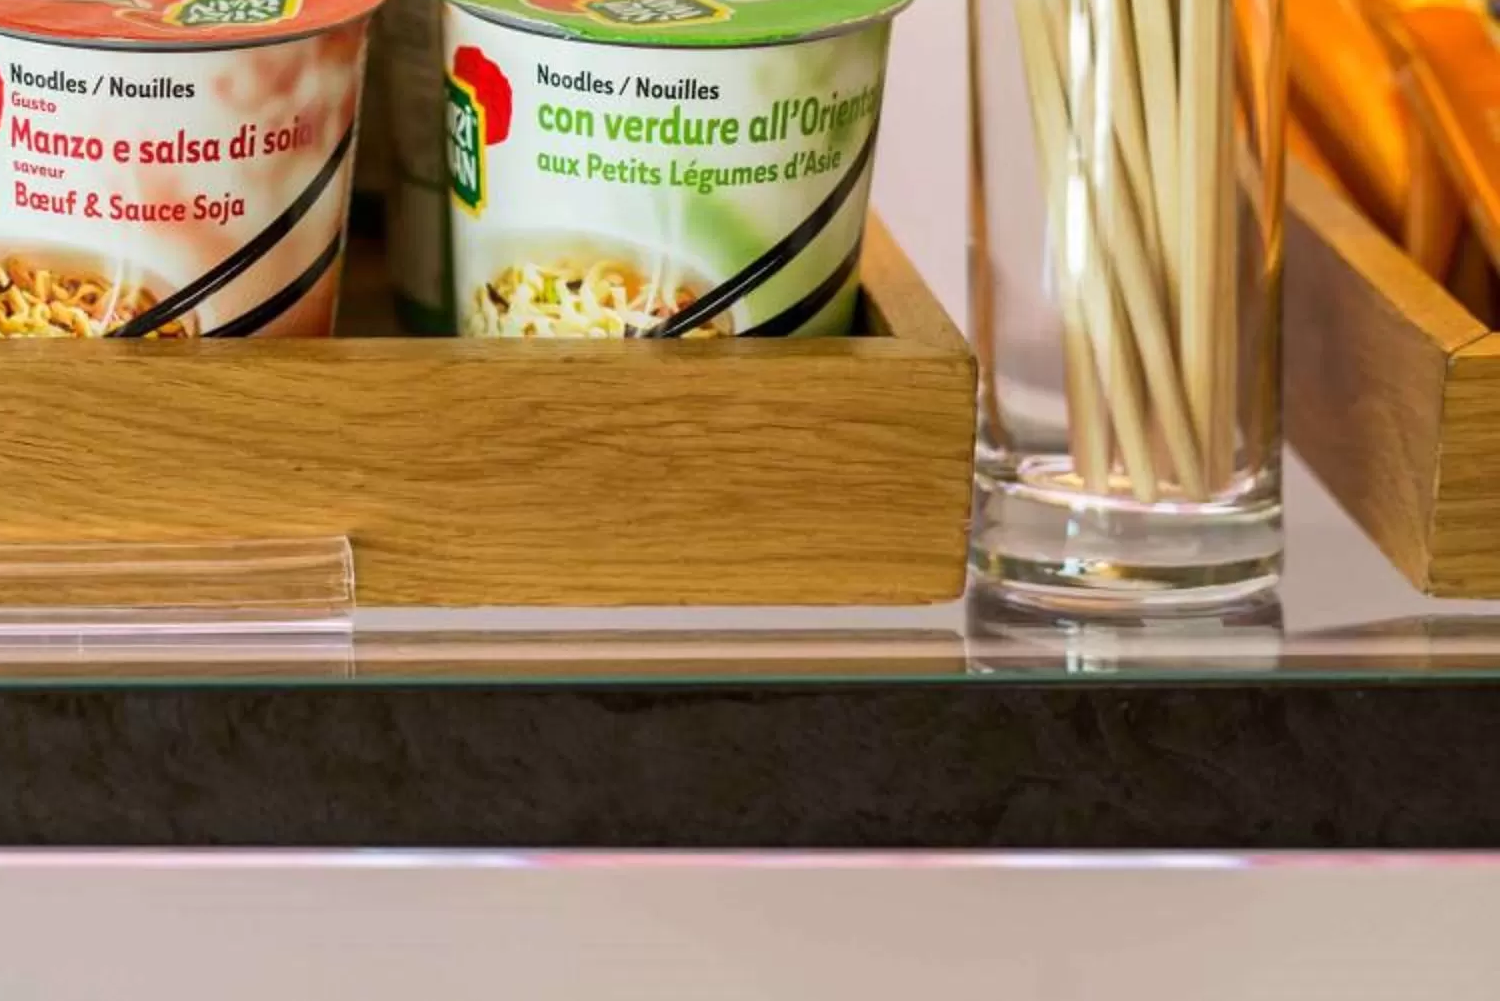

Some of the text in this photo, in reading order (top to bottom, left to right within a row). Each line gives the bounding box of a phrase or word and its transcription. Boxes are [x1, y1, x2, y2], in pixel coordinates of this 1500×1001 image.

[10, 62, 87, 94] Noodles
[109, 76, 195, 99] Nouilles
[537, 63, 614, 95] Noodles
[636, 76, 720, 100] Nouilles
[11, 91, 57, 113] Gusto
[11, 115, 313, 164] Manzo e salsa di soia
[537, 103, 594, 137] con
[603, 104, 739, 146] verdure
[13, 160, 65, 179] saveur
[537, 147, 842, 195] aux Petits Légumes d'Asie
[15, 180, 245, 225] Bœuf & Sauce Soja
